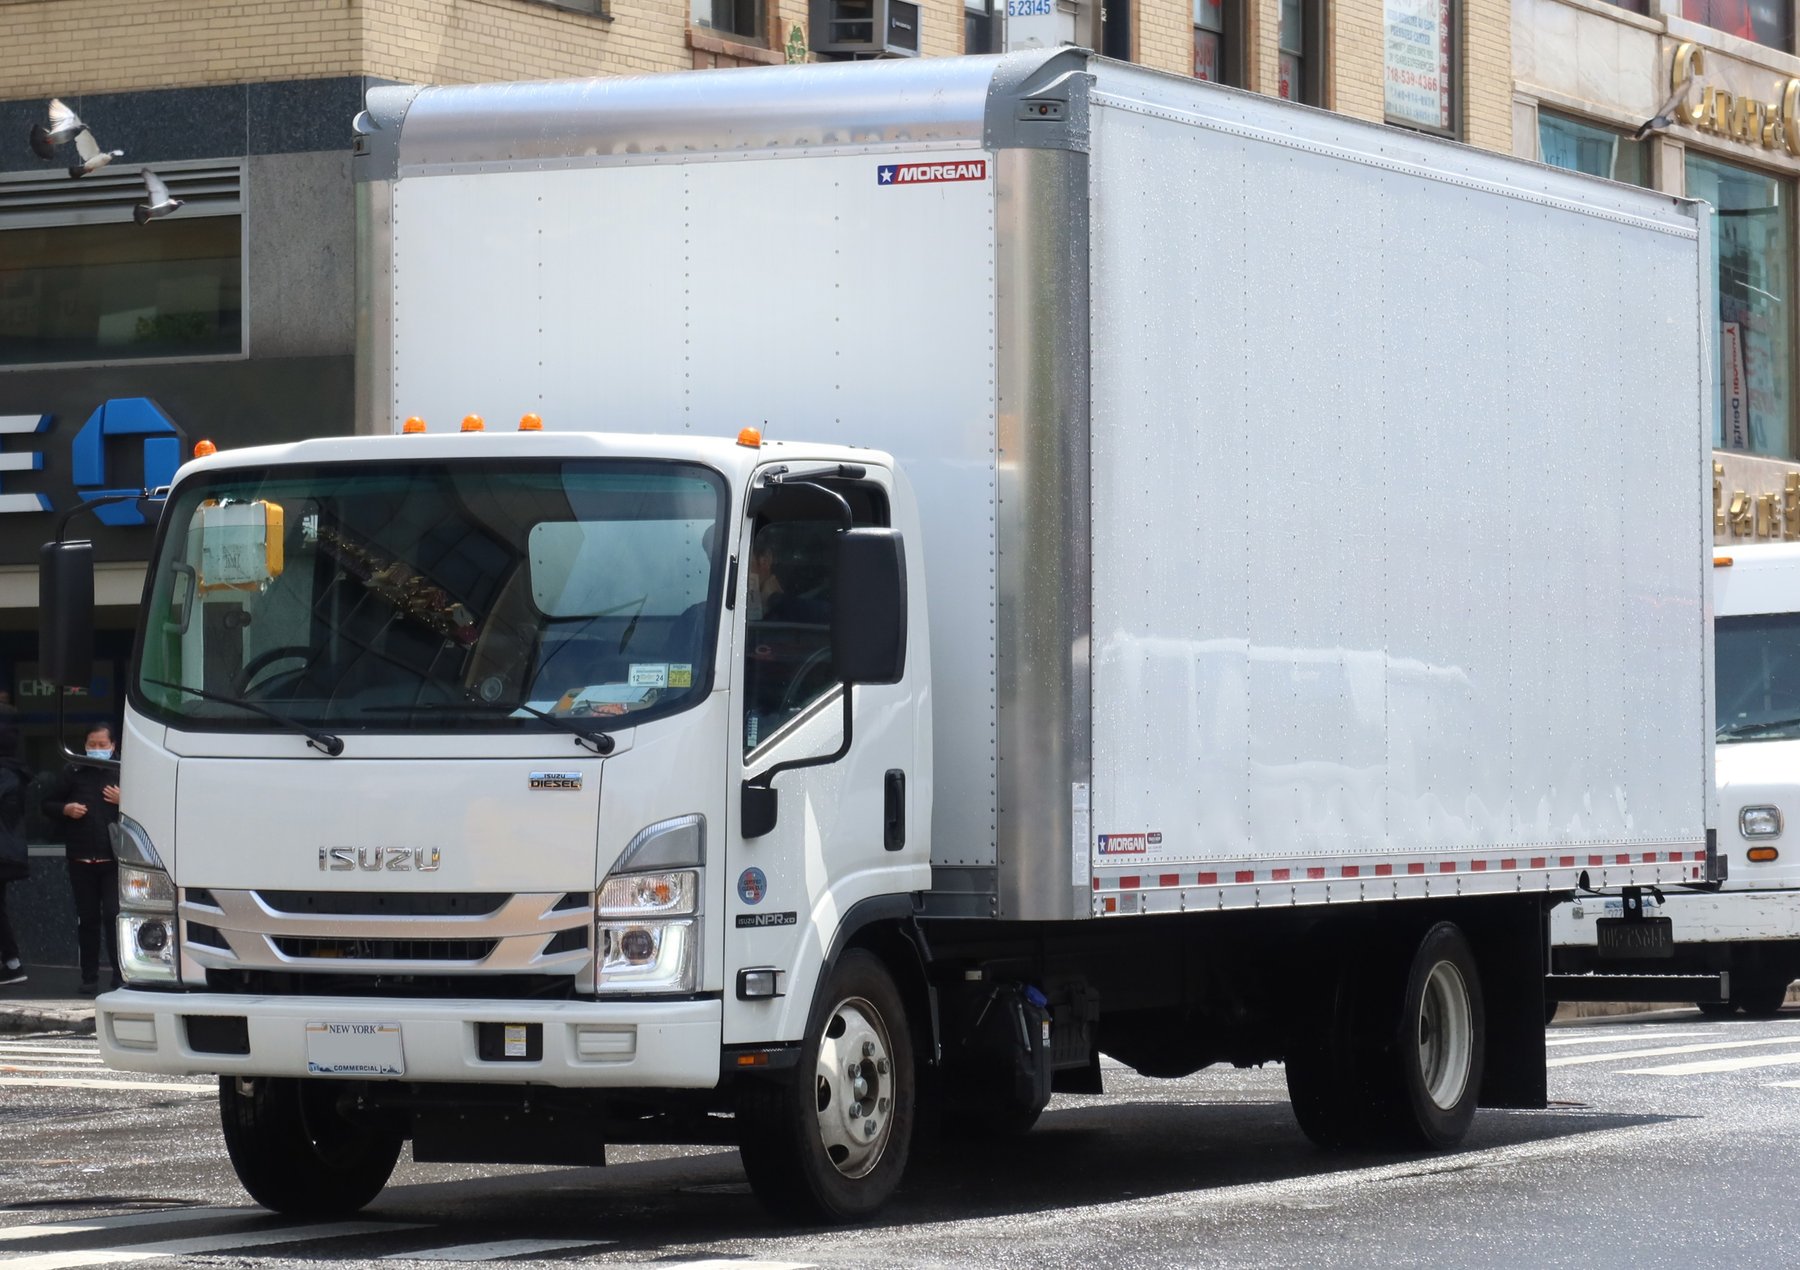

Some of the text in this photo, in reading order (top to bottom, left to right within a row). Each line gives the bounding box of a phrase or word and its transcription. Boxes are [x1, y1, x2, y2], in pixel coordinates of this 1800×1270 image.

[898, 164, 981, 181] MORGAN
[632, 674, 640, 682] 12
[656, 674, 664, 682] 24
[531, 780, 578, 788] DIESEL
[1107, 837, 1145, 852] MORGAN
[318, 846, 441, 872] ISUZU
[738, 917, 755, 925] ISUZU
[329, 1024, 377, 1034] NEW YORK
